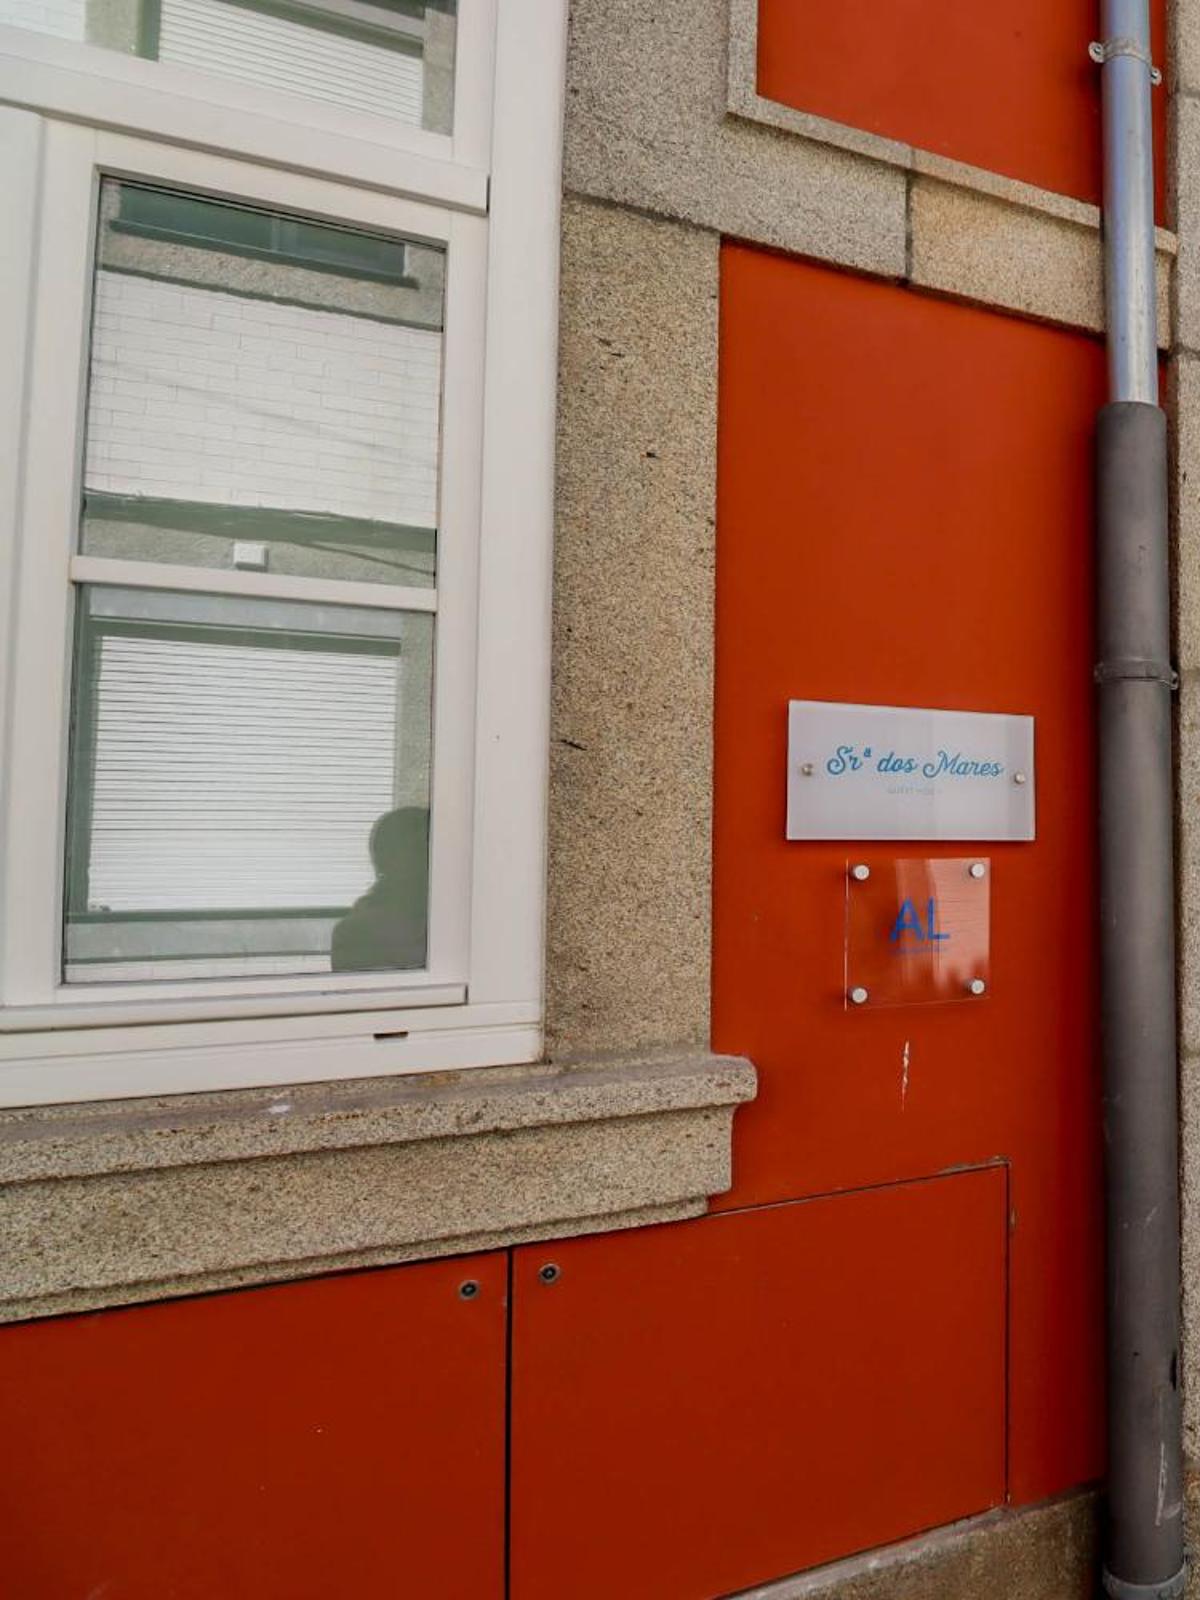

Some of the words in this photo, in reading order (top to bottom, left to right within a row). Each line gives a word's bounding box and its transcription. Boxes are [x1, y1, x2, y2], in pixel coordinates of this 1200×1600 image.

[877, 752, 917, 774] dos
[923, 750, 1003, 779] Mares
[890, 897, 951, 942] AL
